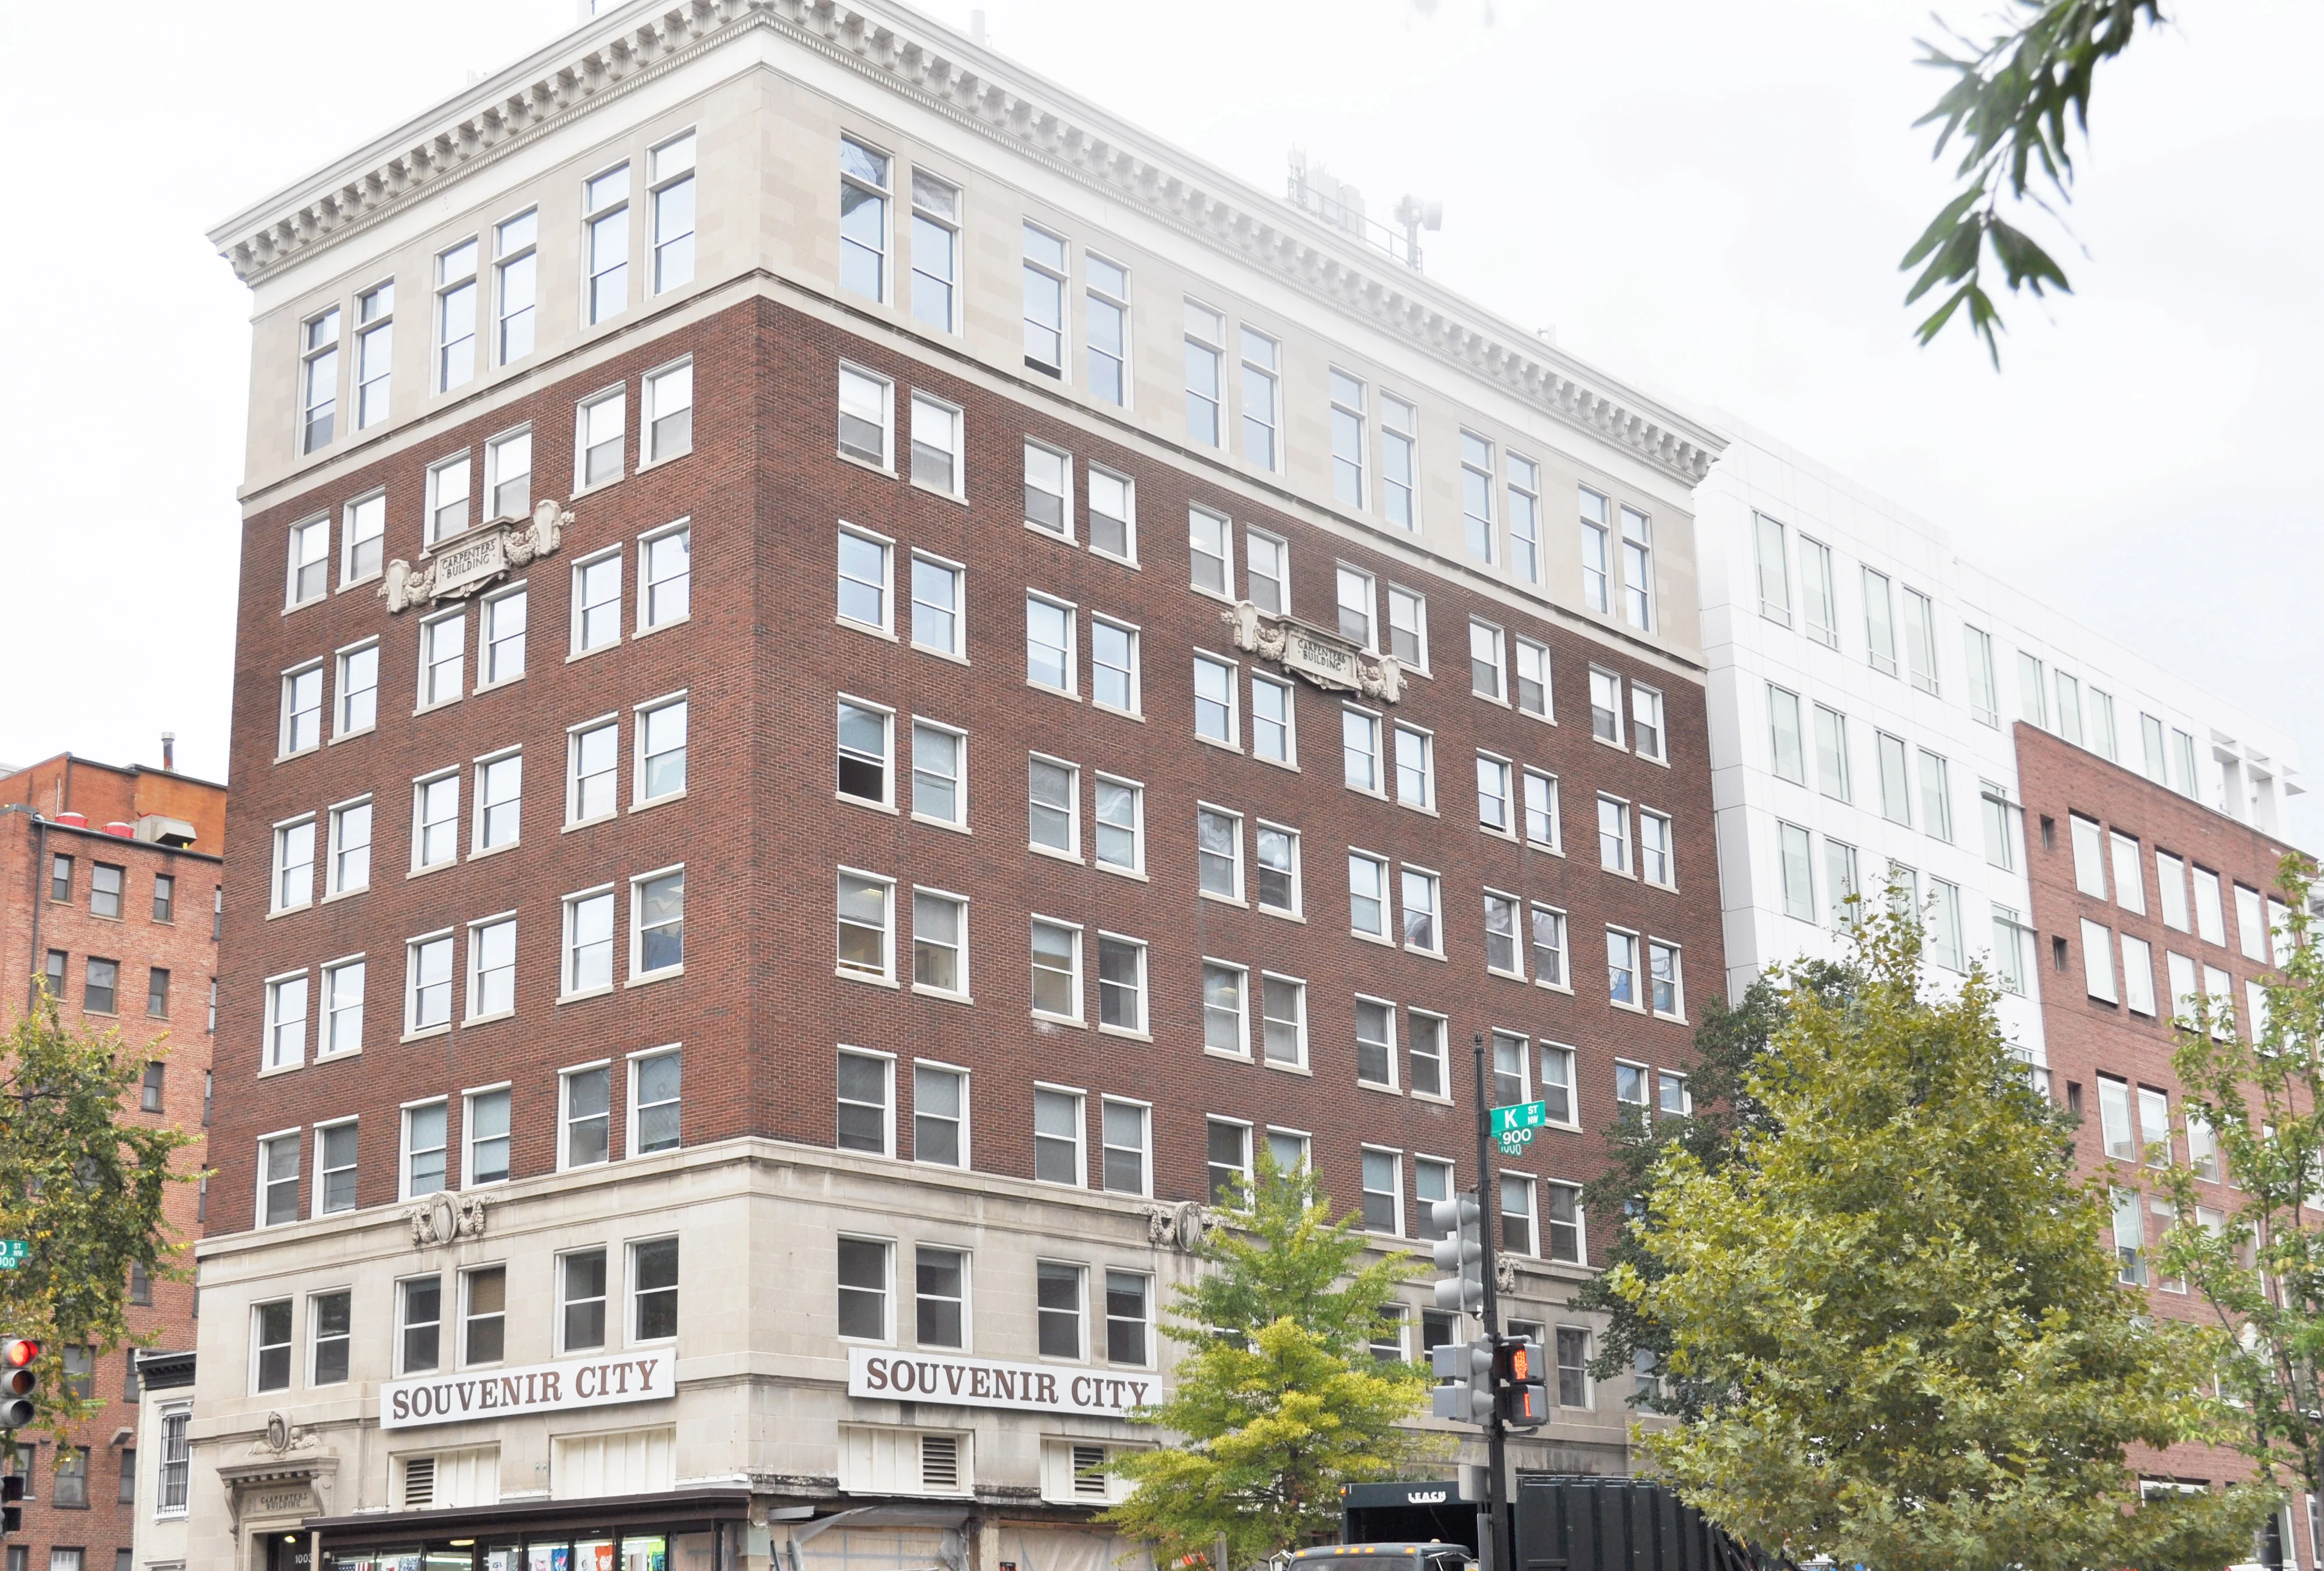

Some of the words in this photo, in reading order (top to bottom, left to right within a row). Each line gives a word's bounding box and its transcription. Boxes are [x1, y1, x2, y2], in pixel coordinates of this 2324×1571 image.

[442, 541, 495, 569] CARPENTERS
[447, 553, 490, 578] BUILDING
[1298, 639, 1346, 664] CARPENTERS
[1303, 652, 1341, 671] BUILDING
[1504, 1109, 1518, 1128] K
[1528, 1105, 1538, 1115] ST
[1528, 1115, 1538, 1124] NW
[1503, 1128, 1531, 1145] 900
[393, 1371, 563, 1420] SOUVENIR
[576, 1359, 658, 1398] CITY
[867, 1358, 1059, 1404] SOUVENIR
[1072, 1376, 1148, 1408] CITY
[261, 1493, 307, 1504] CARPENTERS
[267, 1500, 300, 1509] BUILDING
[1408, 1491, 1446, 1503] LEACH
